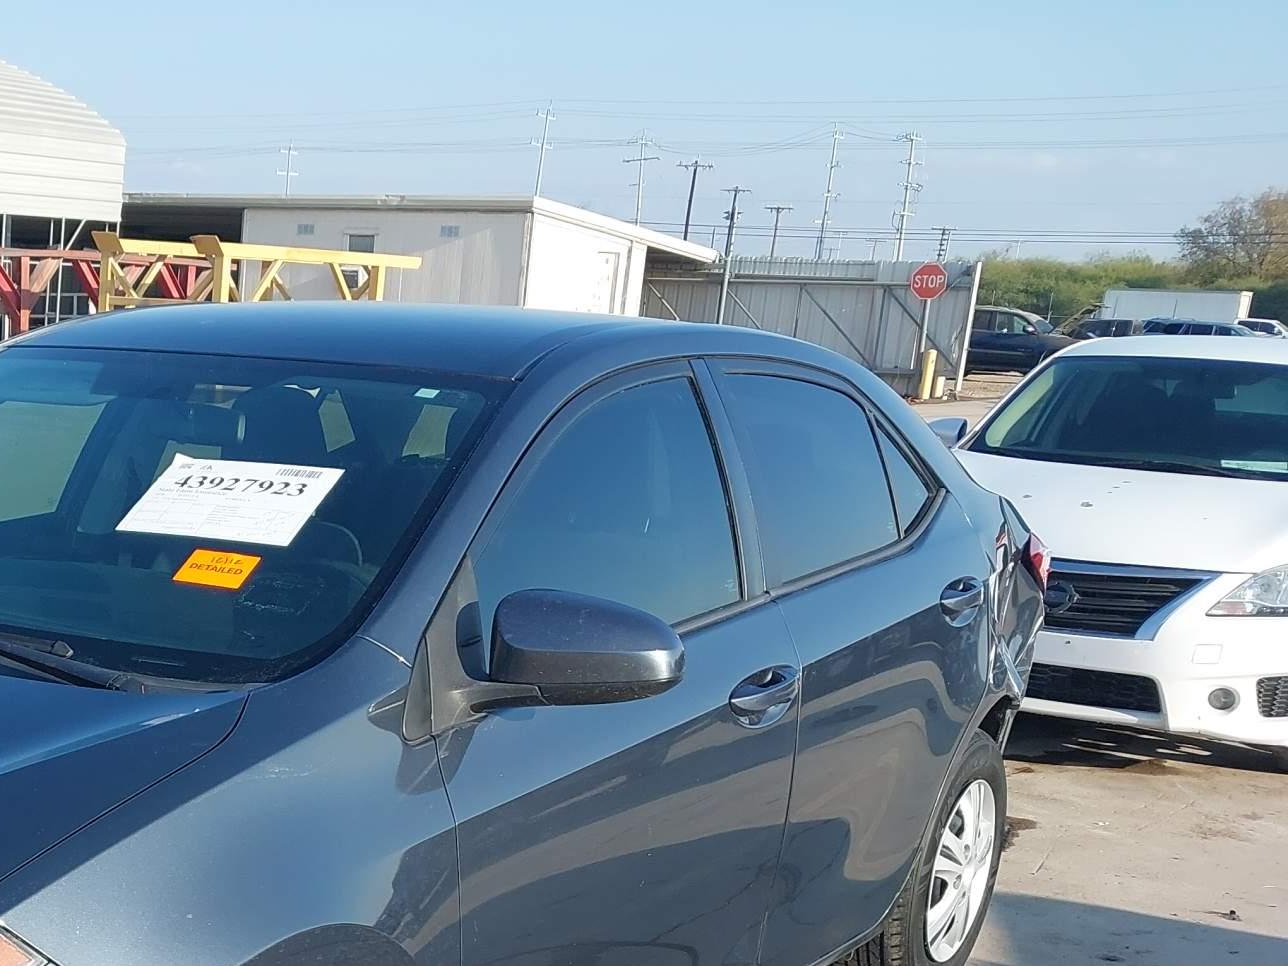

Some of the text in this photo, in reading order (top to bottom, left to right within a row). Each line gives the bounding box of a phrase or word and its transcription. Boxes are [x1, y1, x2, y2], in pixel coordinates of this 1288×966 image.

[913, 275, 944, 288] STOP
[174, 475, 308, 497] 43927923
[189, 562, 244, 575] DETAILED
